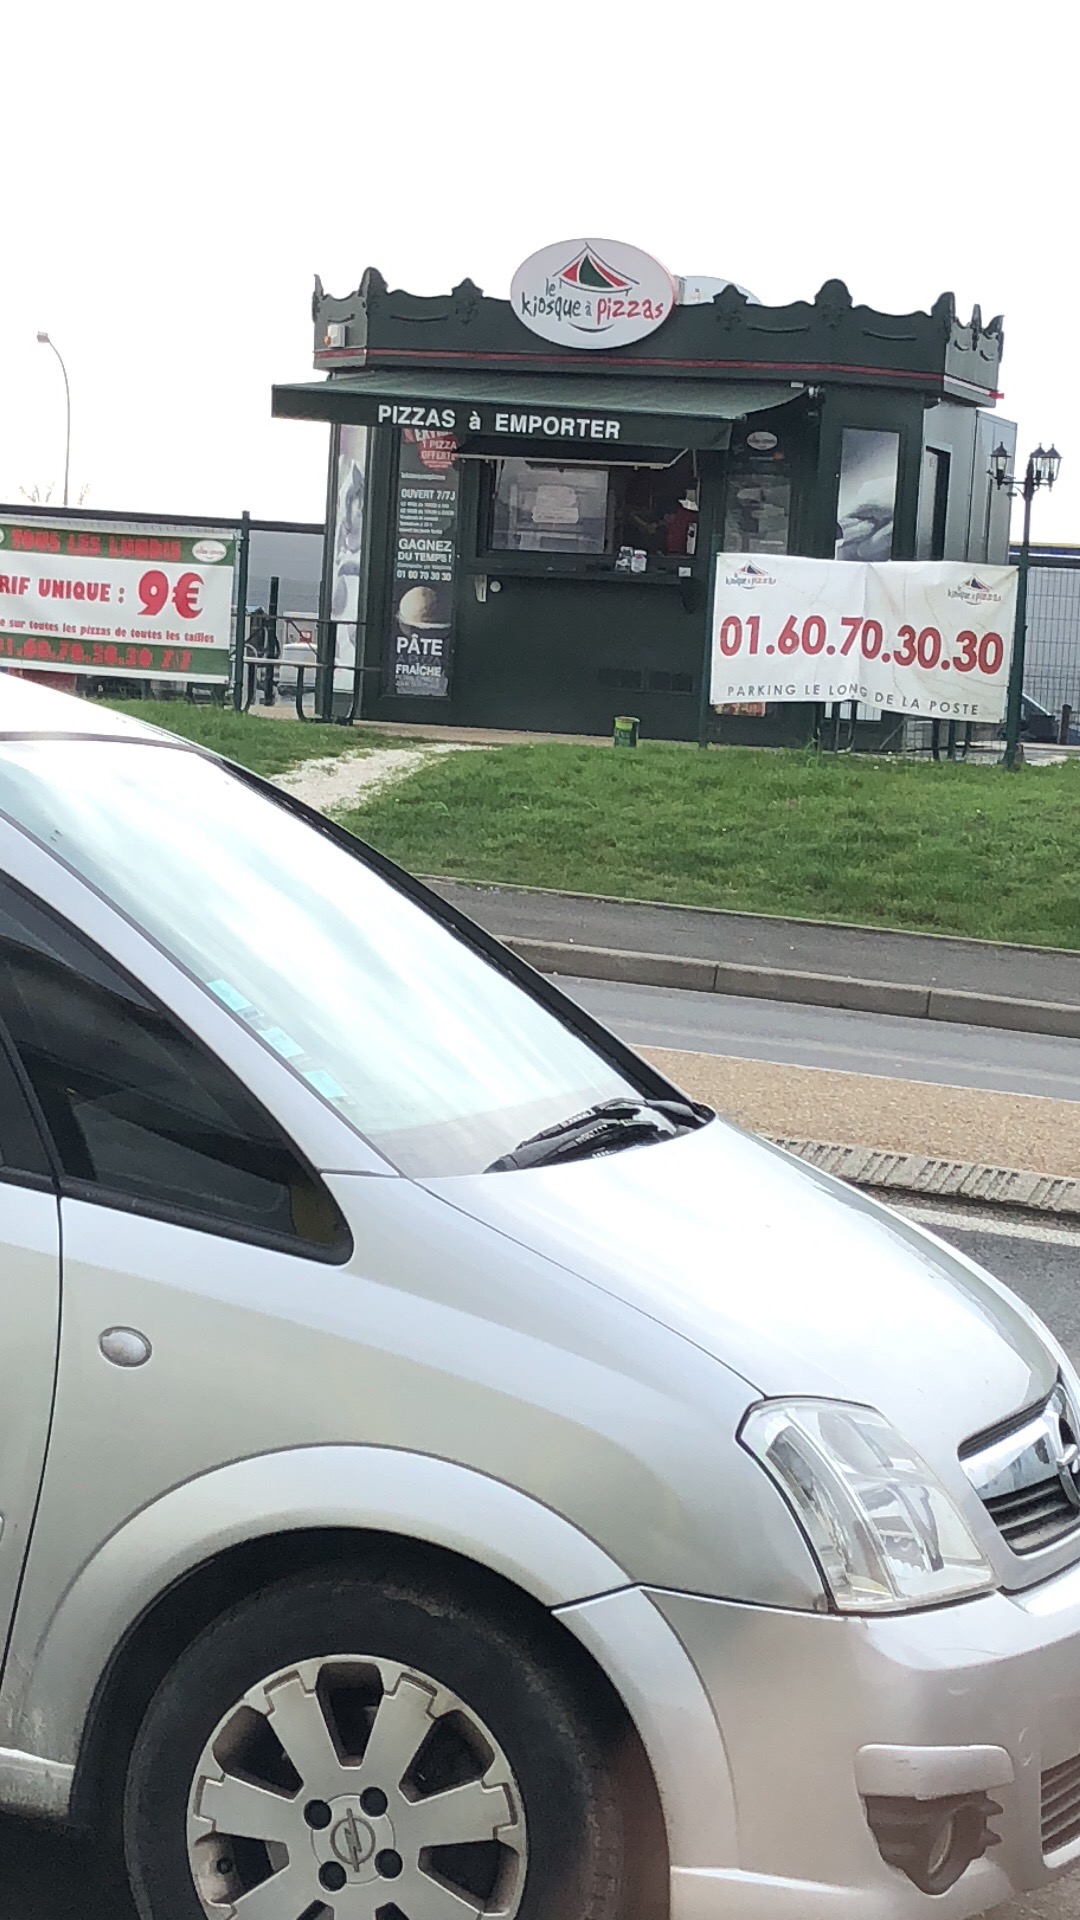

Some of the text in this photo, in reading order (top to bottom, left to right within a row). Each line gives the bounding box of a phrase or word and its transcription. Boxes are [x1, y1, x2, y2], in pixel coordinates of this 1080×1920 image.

[545, 278, 556, 297] le
[521, 292, 664, 325] kiosque à pizzas
[378, 404, 621, 440] PIZZAS à EMPORTER
[429, 440, 457, 450] PIZZA
[401, 488, 435, 499] OUVERT
[11, 528, 181, 562] TOUS LES LUNDIS
[397, 551, 412, 561] DU
[414, 552, 447, 562] TEMPS
[398, 538, 452, 552] GAGNEZ
[39, 578, 111, 602] UNIQUE
[137, 569, 204, 619] 9€
[9, 619, 26, 629] sur
[29, 620, 58, 632] toutes
[63, 623, 76, 633] les
[80, 625, 110, 636] pizzas
[115, 627, 127, 638] de
[131, 628, 162, 640] toutes
[166, 630, 180, 641] les
[184, 631, 215, 644] tailles
[396, 633, 443, 656] PÂTE
[720, 614, 1004, 675] 01.60.70.30.30
[395, 663, 442, 677] FRAÎCHE
[727, 682, 979, 716] PARKING LE LONG DE LA POSTE
